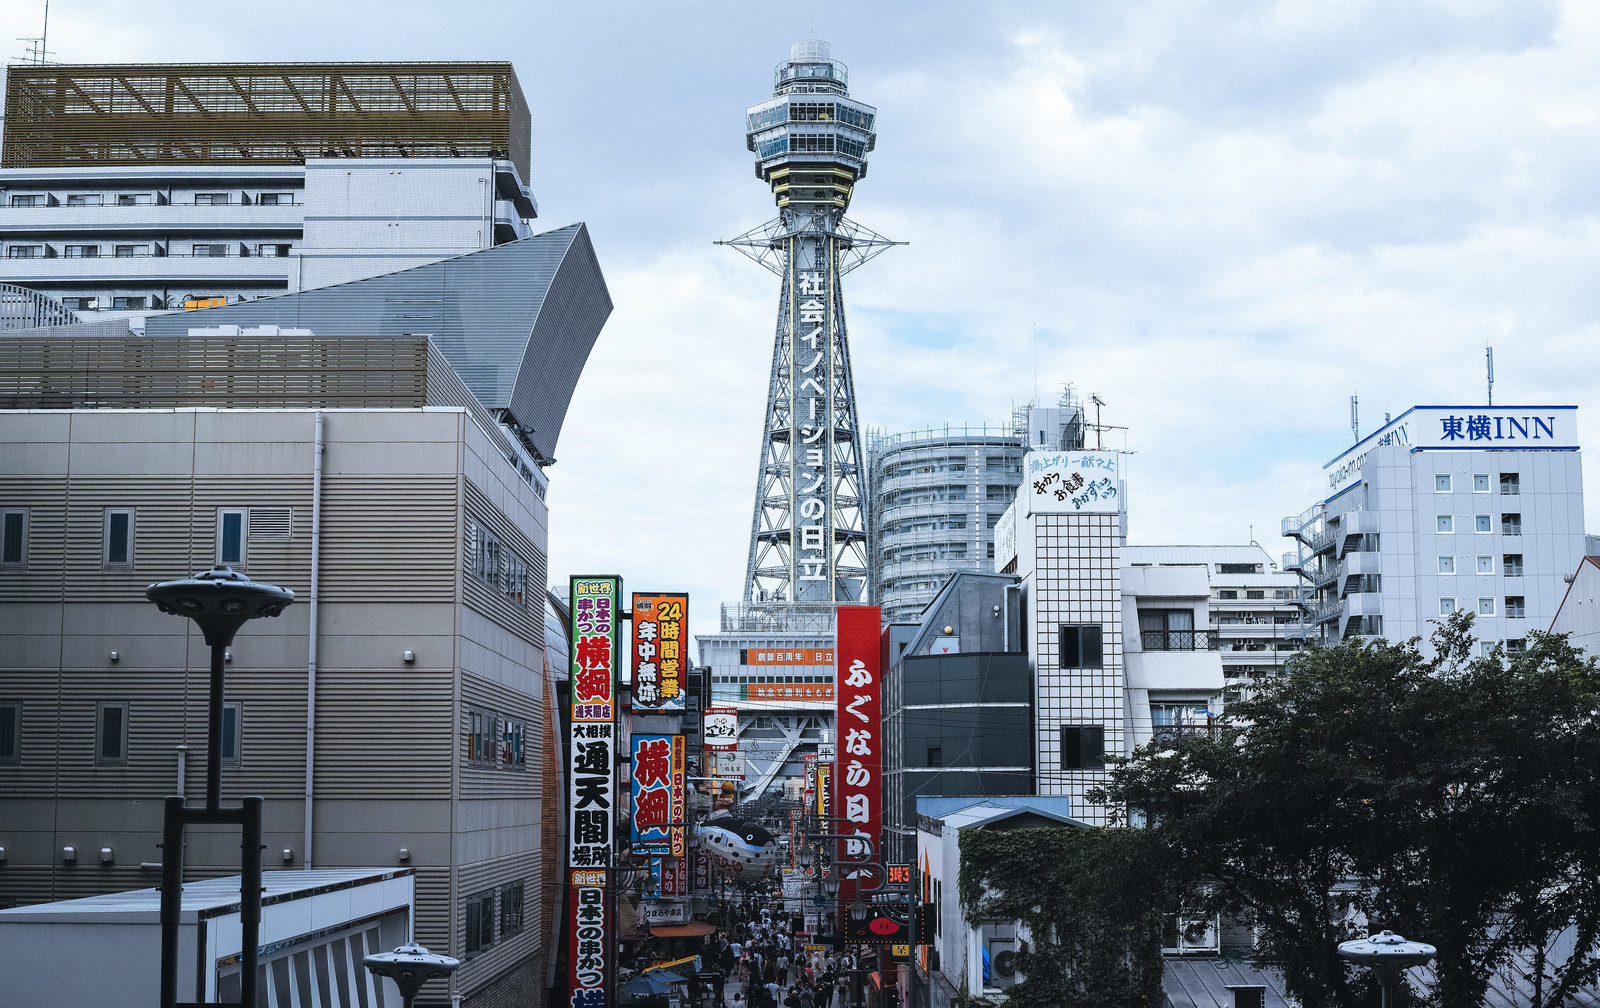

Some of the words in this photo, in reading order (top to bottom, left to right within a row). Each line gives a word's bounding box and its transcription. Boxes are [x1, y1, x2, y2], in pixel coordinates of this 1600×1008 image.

[799, 271, 827, 581] 社会イノベーションの日立
[1439, 415, 1556, 441] 東横INN
[1053, 472, 1085, 502] お食事
[576, 581, 613, 596] 新世界
[576, 597, 595, 634] 串かつ
[594, 597, 611, 634] 日本一の
[574, 635, 612, 702] 横綱
[637, 620, 658, 702] 年中無休
[657, 601, 684, 699] 24時間営業
[815, 652, 833, 662] 日立
[574, 704, 612, 719] 通天閣店
[573, 724, 612, 739] 大相撲
[573, 740, 611, 844] 通天閣
[633, 739, 671, 835] 横綱
[577, 889, 604, 987] 日本一の串かつ
